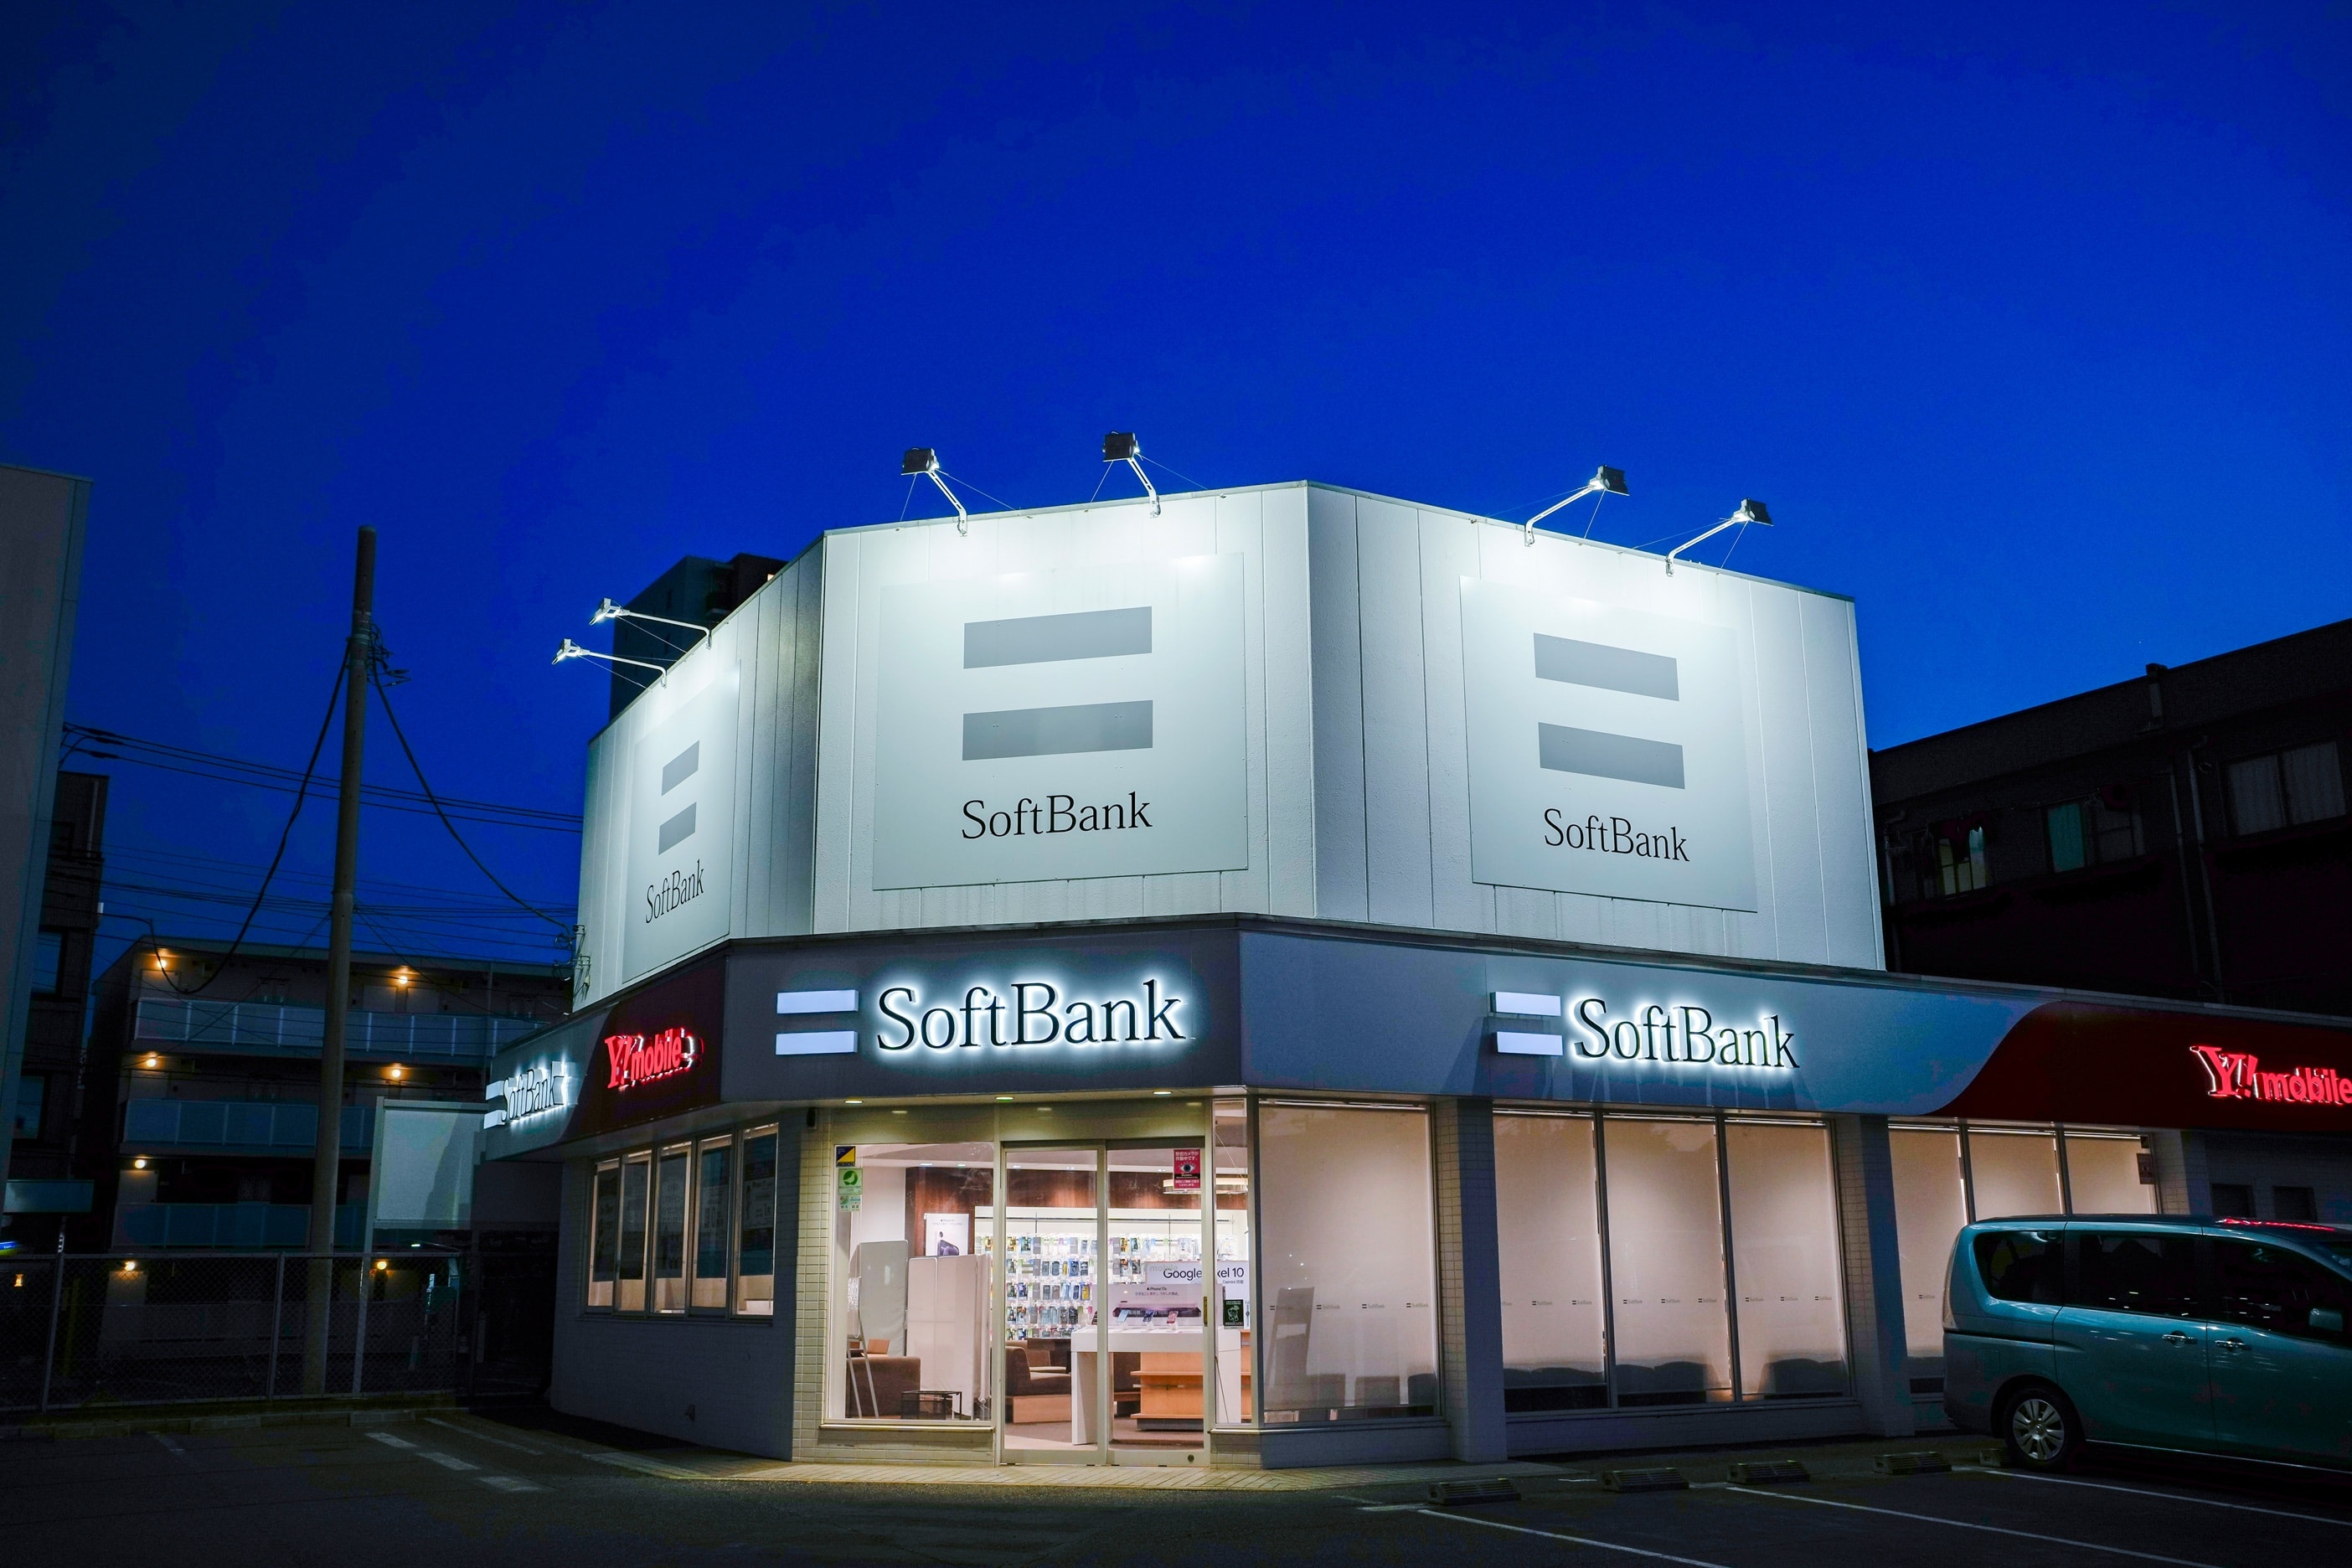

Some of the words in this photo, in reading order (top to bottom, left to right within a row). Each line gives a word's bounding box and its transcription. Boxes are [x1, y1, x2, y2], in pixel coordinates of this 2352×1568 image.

[962, 791, 1153, 839] SoftBank
[1544, 807, 1690, 862] SoftBank
[645, 859, 704, 924] SoftBank
[877, 978, 1187, 1050] SoftBank
[1573, 998, 1800, 1069] SoftBank
[605, 1029, 685, 1089] Y!mobile
[2190, 1045, 2352, 1105] Y!mobile
[502, 1060, 566, 1123] SoftBank
[1163, 1267, 1203, 1282] Google
[1232, 1266, 1245, 1278] 10
